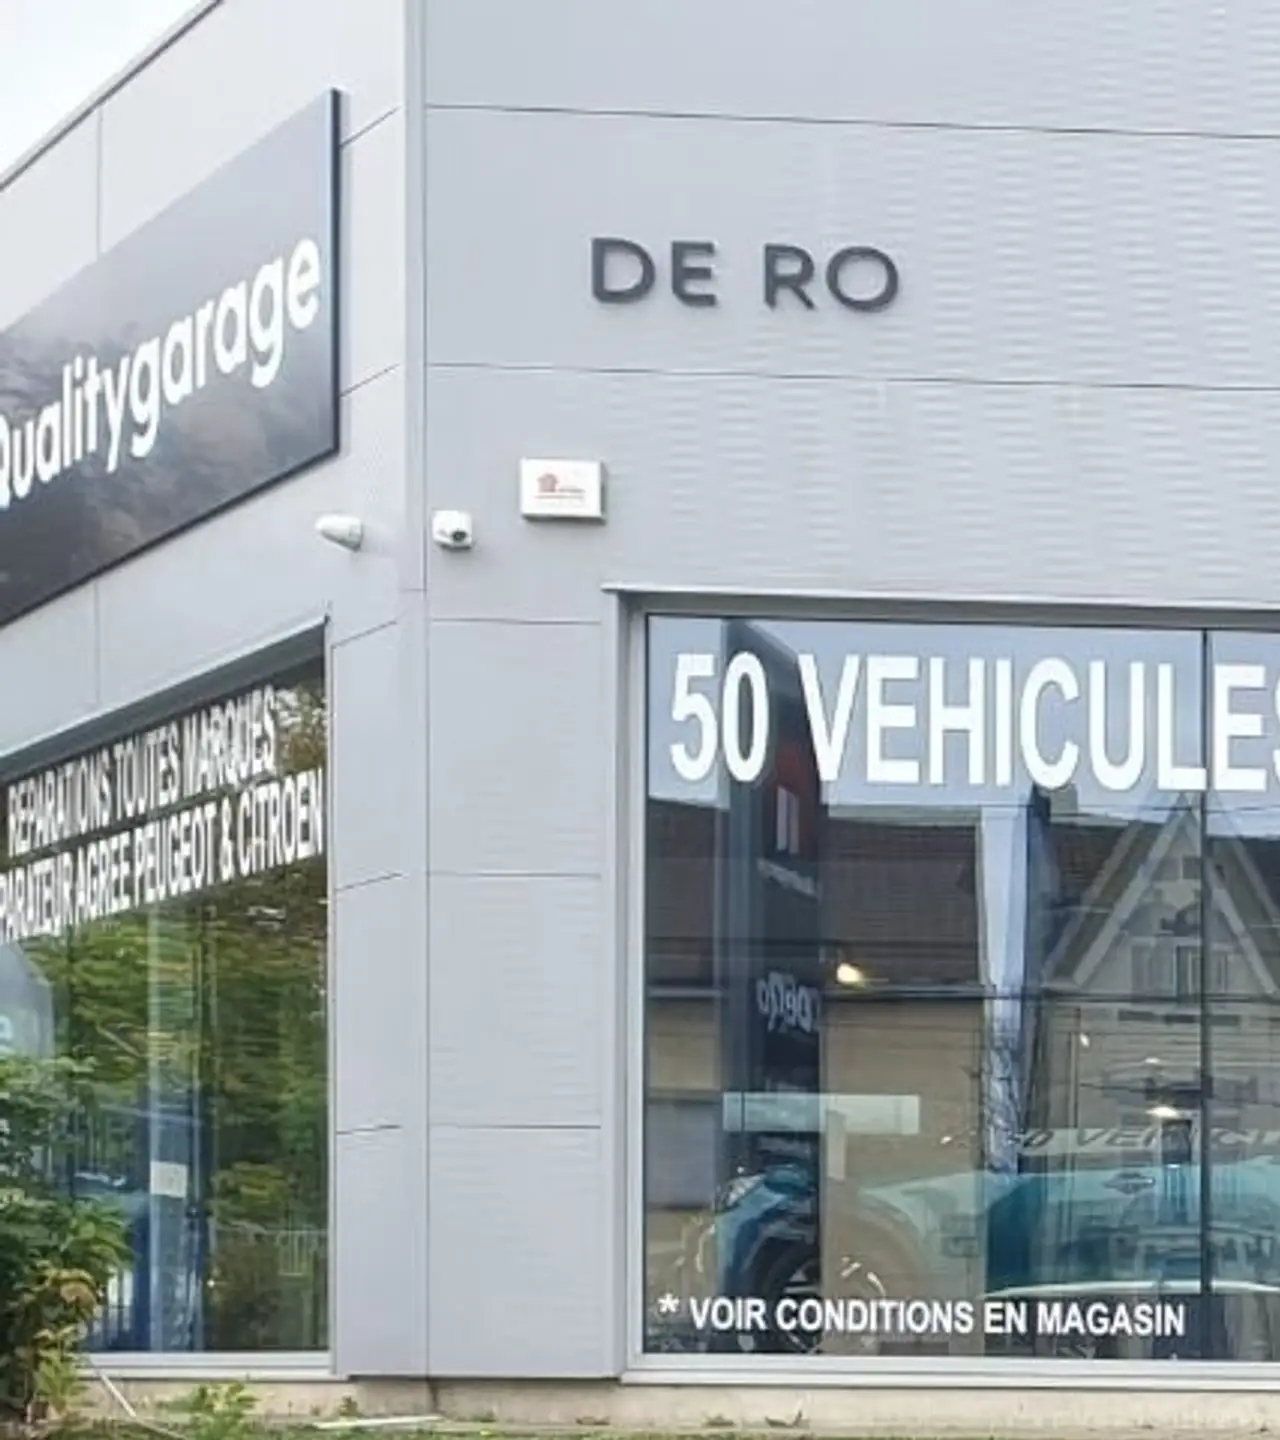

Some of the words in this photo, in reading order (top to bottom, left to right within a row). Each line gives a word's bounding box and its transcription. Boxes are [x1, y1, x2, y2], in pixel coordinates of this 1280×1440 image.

[591, 237, 717, 307] DE
[763, 243, 899, 311] RO
[8, 747, 111, 858] REPARATIONS
[113, 720, 179, 821] TOUTES
[184, 685, 276, 798] MARQUES
[670, 651, 769, 783] 50
[76, 831, 131, 928] AGREE
[134, 801, 217, 909] PEUGEOT
[237, 767, 324, 876] CITROEN
[689, 1297, 768, 1331] VOIR
[775, 1297, 975, 1334] CONDITIONS
[983, 1302, 1028, 1334] EN
[1037, 1302, 1186, 1337] MAGASIN
